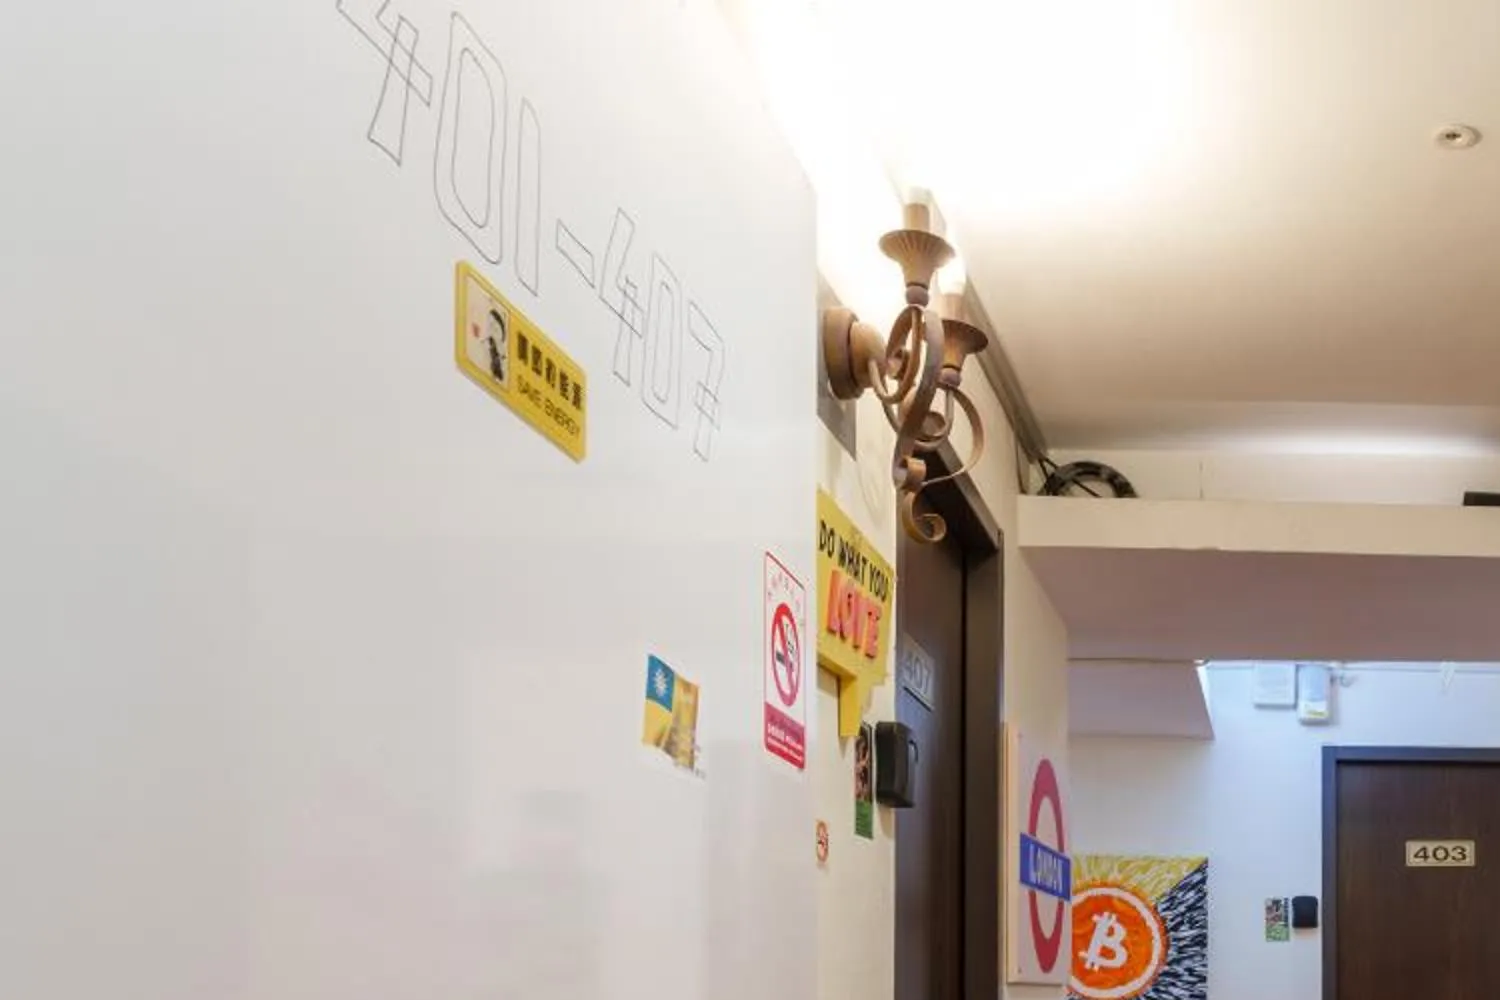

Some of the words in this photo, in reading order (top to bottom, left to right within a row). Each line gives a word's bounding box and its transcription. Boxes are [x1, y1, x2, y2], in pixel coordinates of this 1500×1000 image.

[517, 376, 542, 409] SAVE
[545, 397, 580, 438] ENERGY
[818, 519, 835, 558] DO
[838, 536, 869, 586] WHAT
[869, 562, 889, 603] YOU
[826, 568, 883, 660] LOVE
[902, 650, 933, 694] 407
[1028, 842, 1064, 895] LONDON
[1413, 845, 1467, 862] 403
